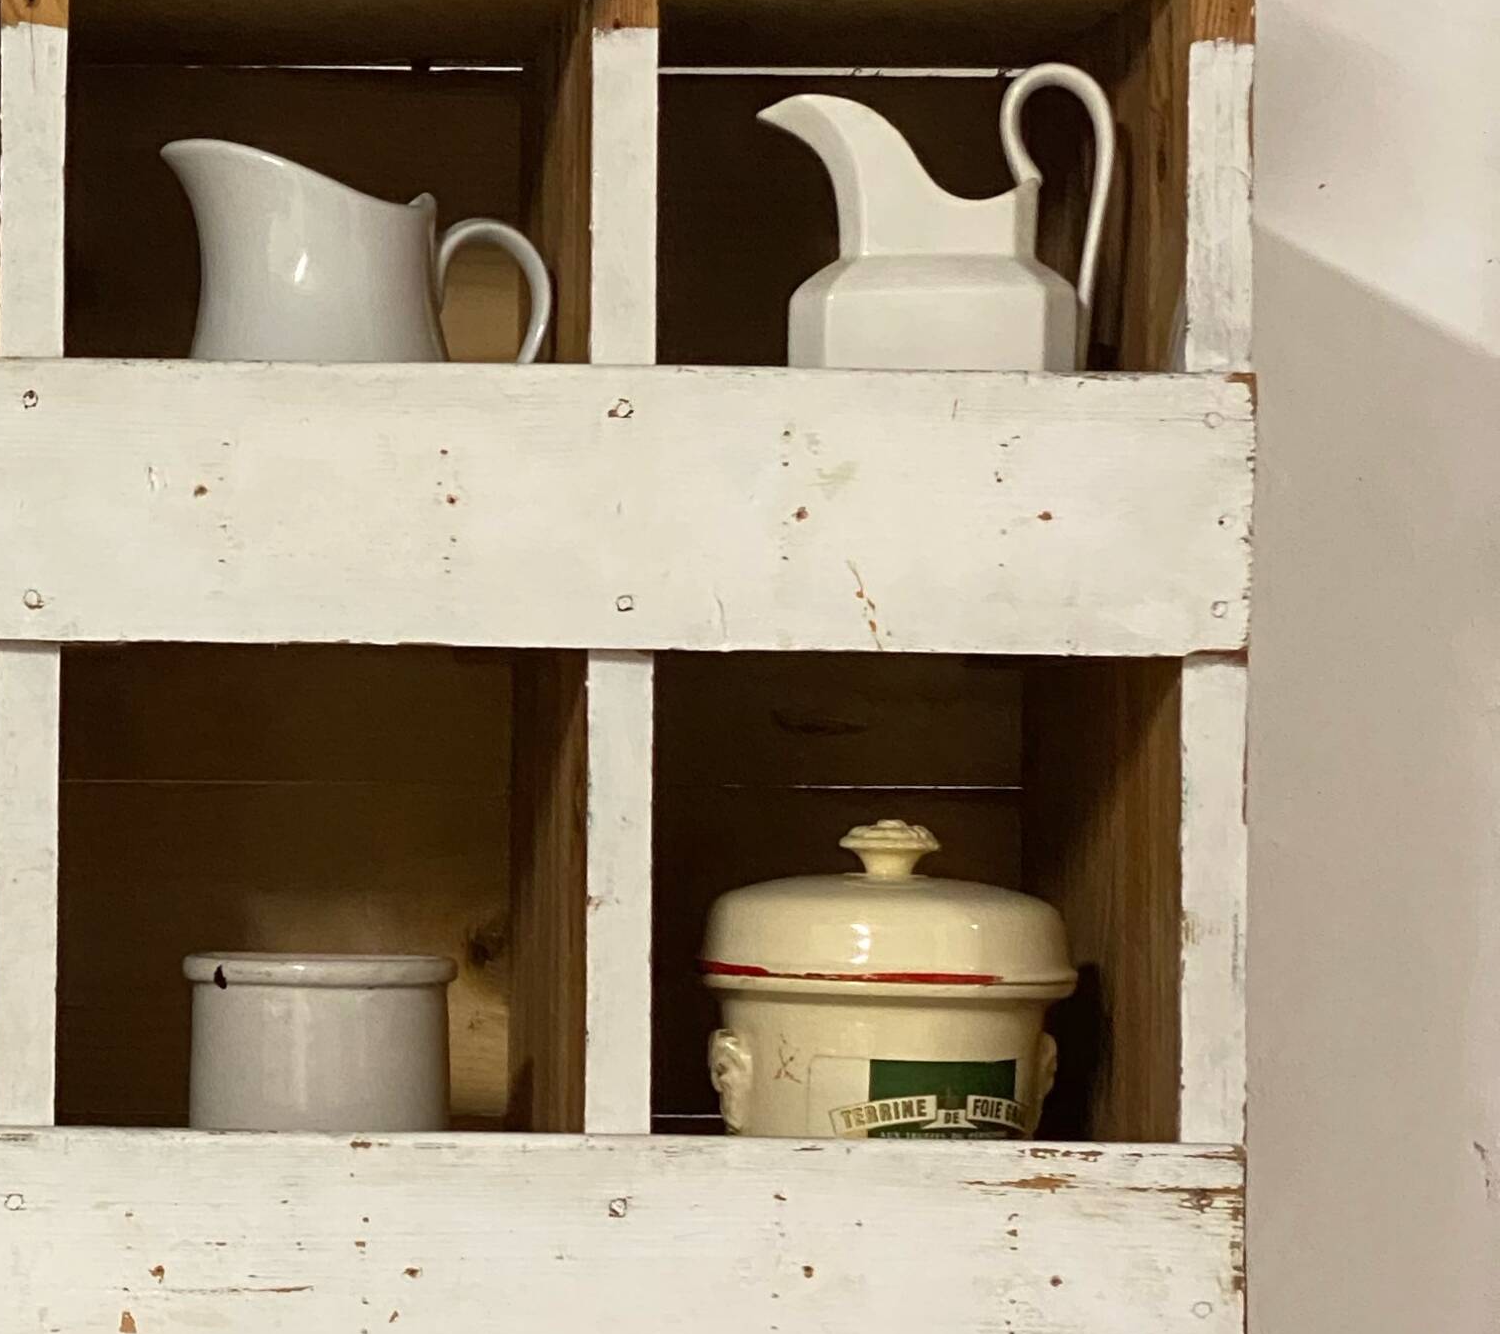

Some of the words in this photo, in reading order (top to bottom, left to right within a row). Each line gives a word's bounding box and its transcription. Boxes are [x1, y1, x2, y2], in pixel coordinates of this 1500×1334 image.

[840, 1099, 928, 1128] TERRINE
[944, 1111, 960, 1125] DE
[973, 1098, 1001, 1119] FOIE
